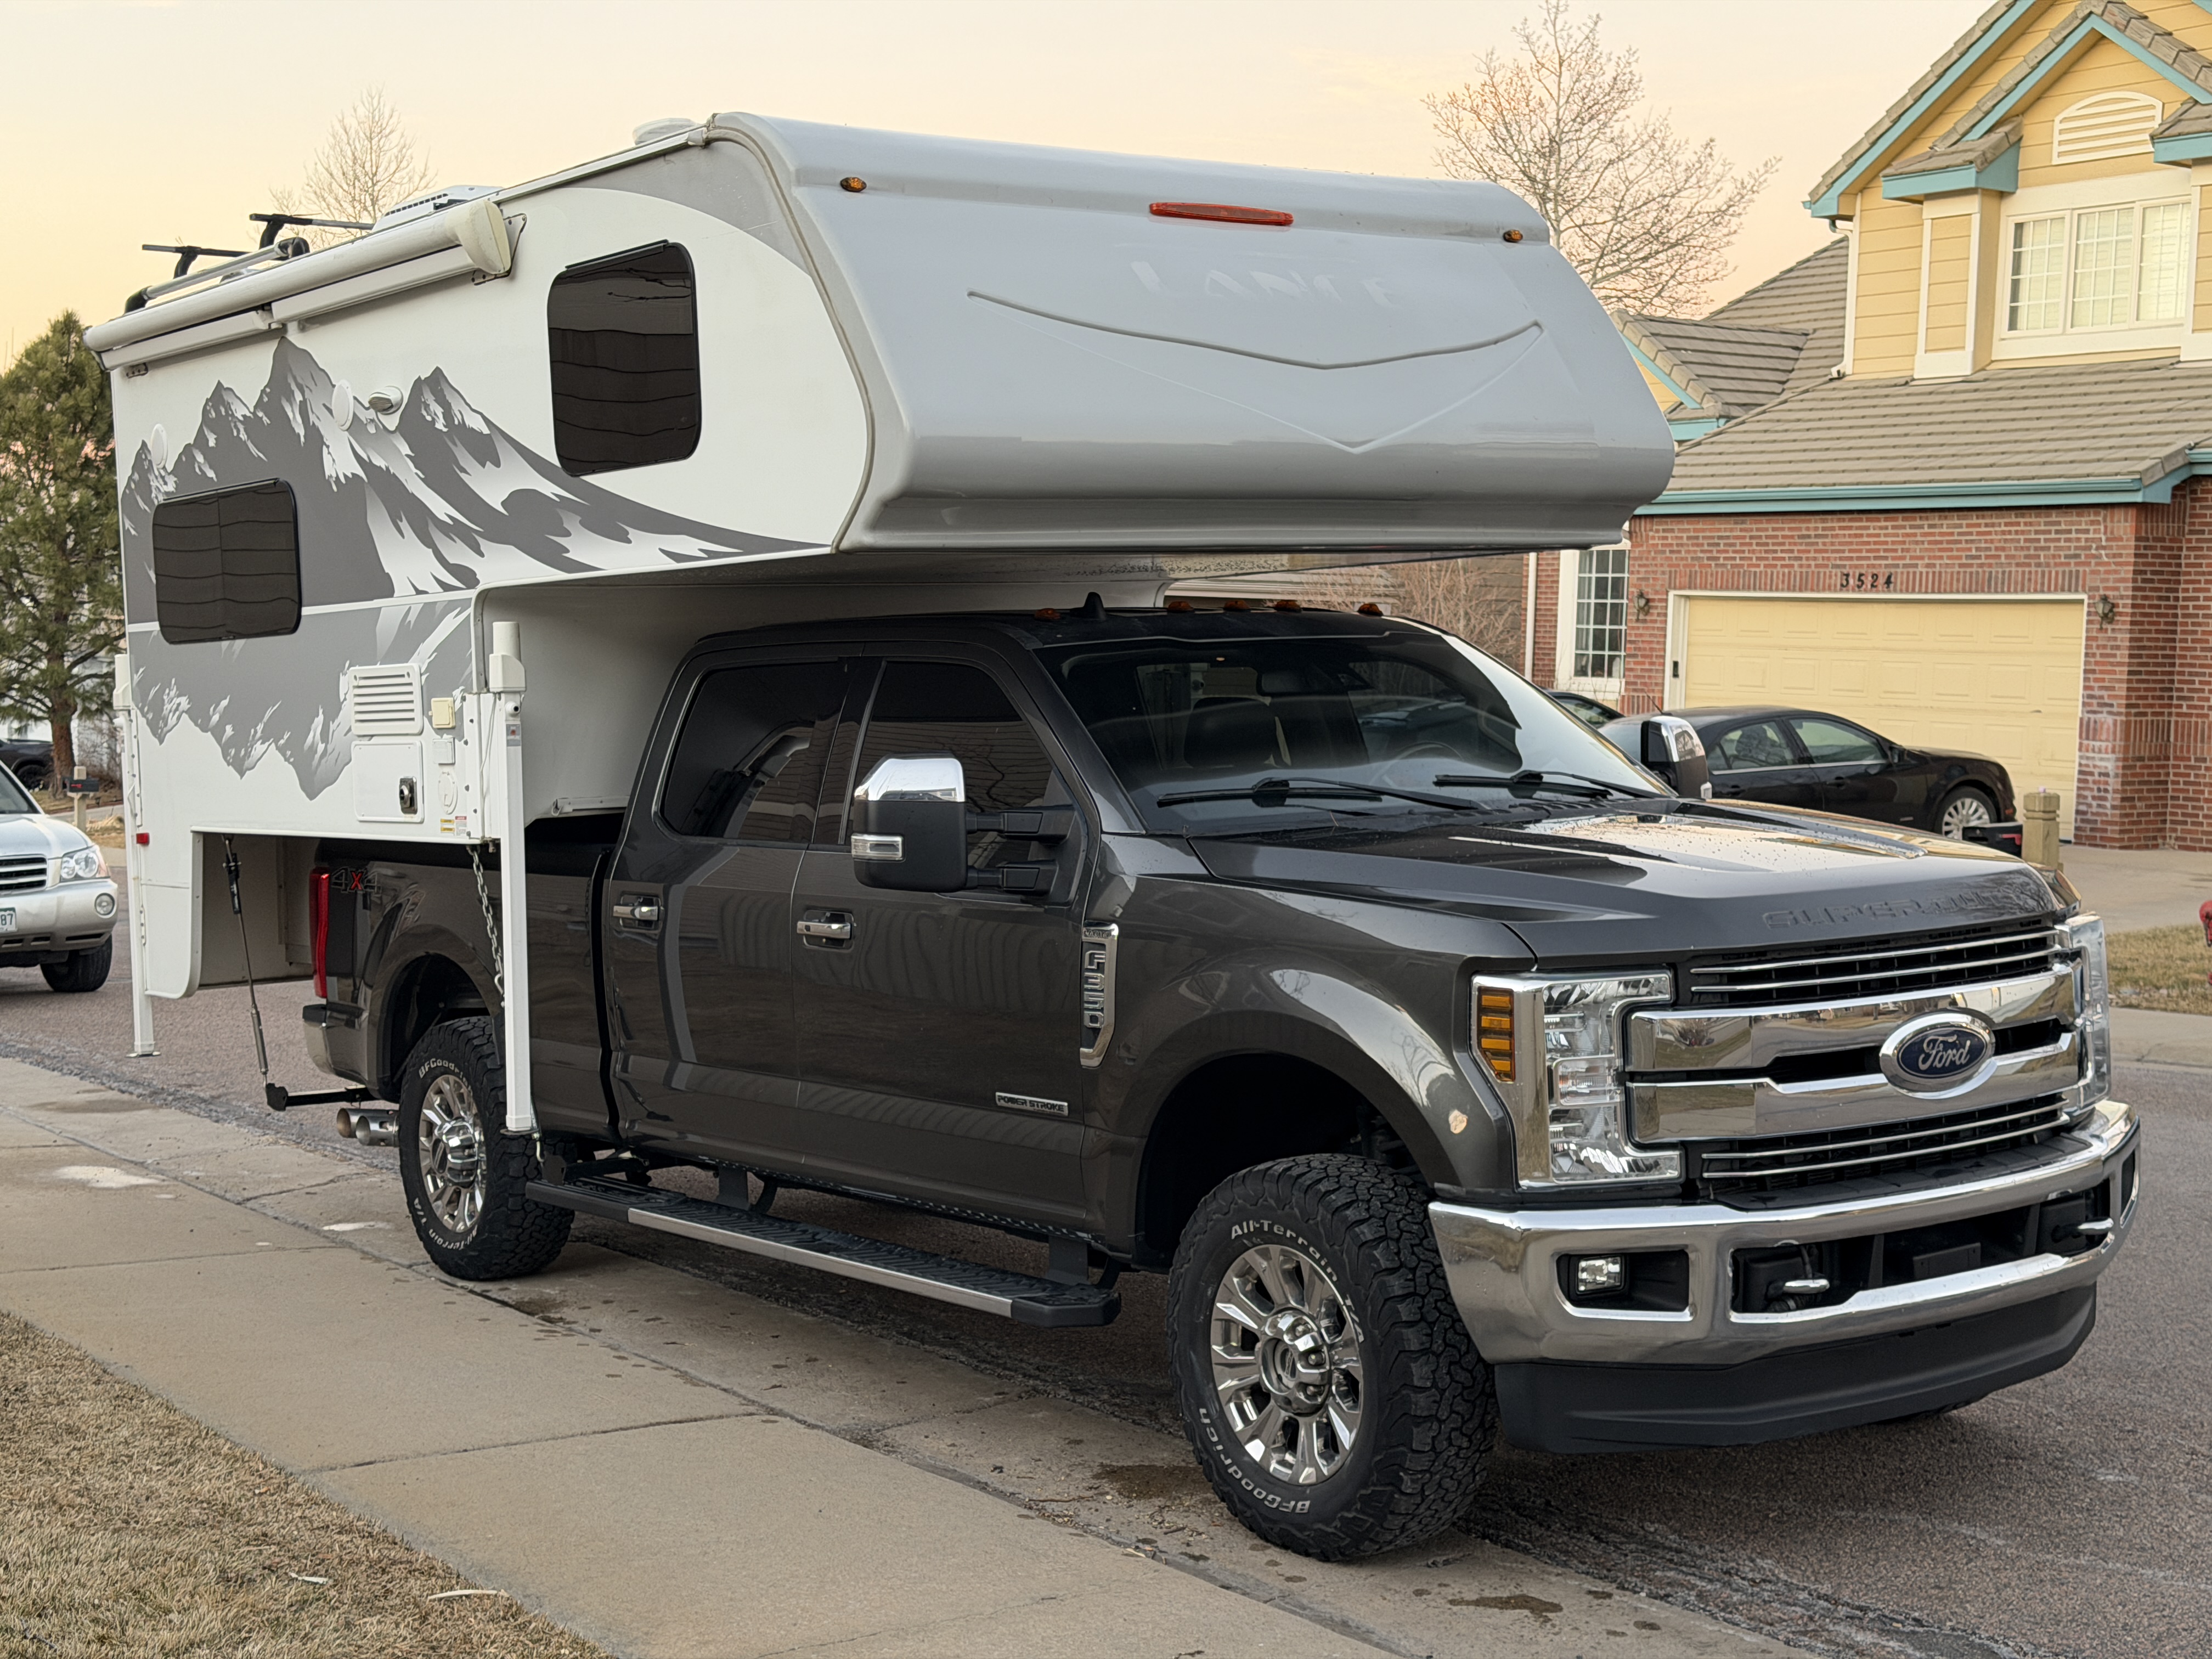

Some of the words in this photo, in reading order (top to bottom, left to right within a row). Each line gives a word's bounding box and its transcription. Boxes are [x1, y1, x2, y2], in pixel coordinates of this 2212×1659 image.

[1841, 571, 1893, 589] 3524
[1, 913, 13, 926] 87
[1762, 899, 1921, 929] SUPER
[1084, 950, 1105, 1029] F350
[1918, 1034, 1971, 1071] Ford
[997, 1094, 1028, 1107] POWER
[1029, 1099, 1065, 1112] STROKE
[1231, 1220, 1338, 1282] All-Terrain
[1345, 1294, 1364, 1344] T/A
[1199, 1408, 1311, 1514] BFGoodrich
